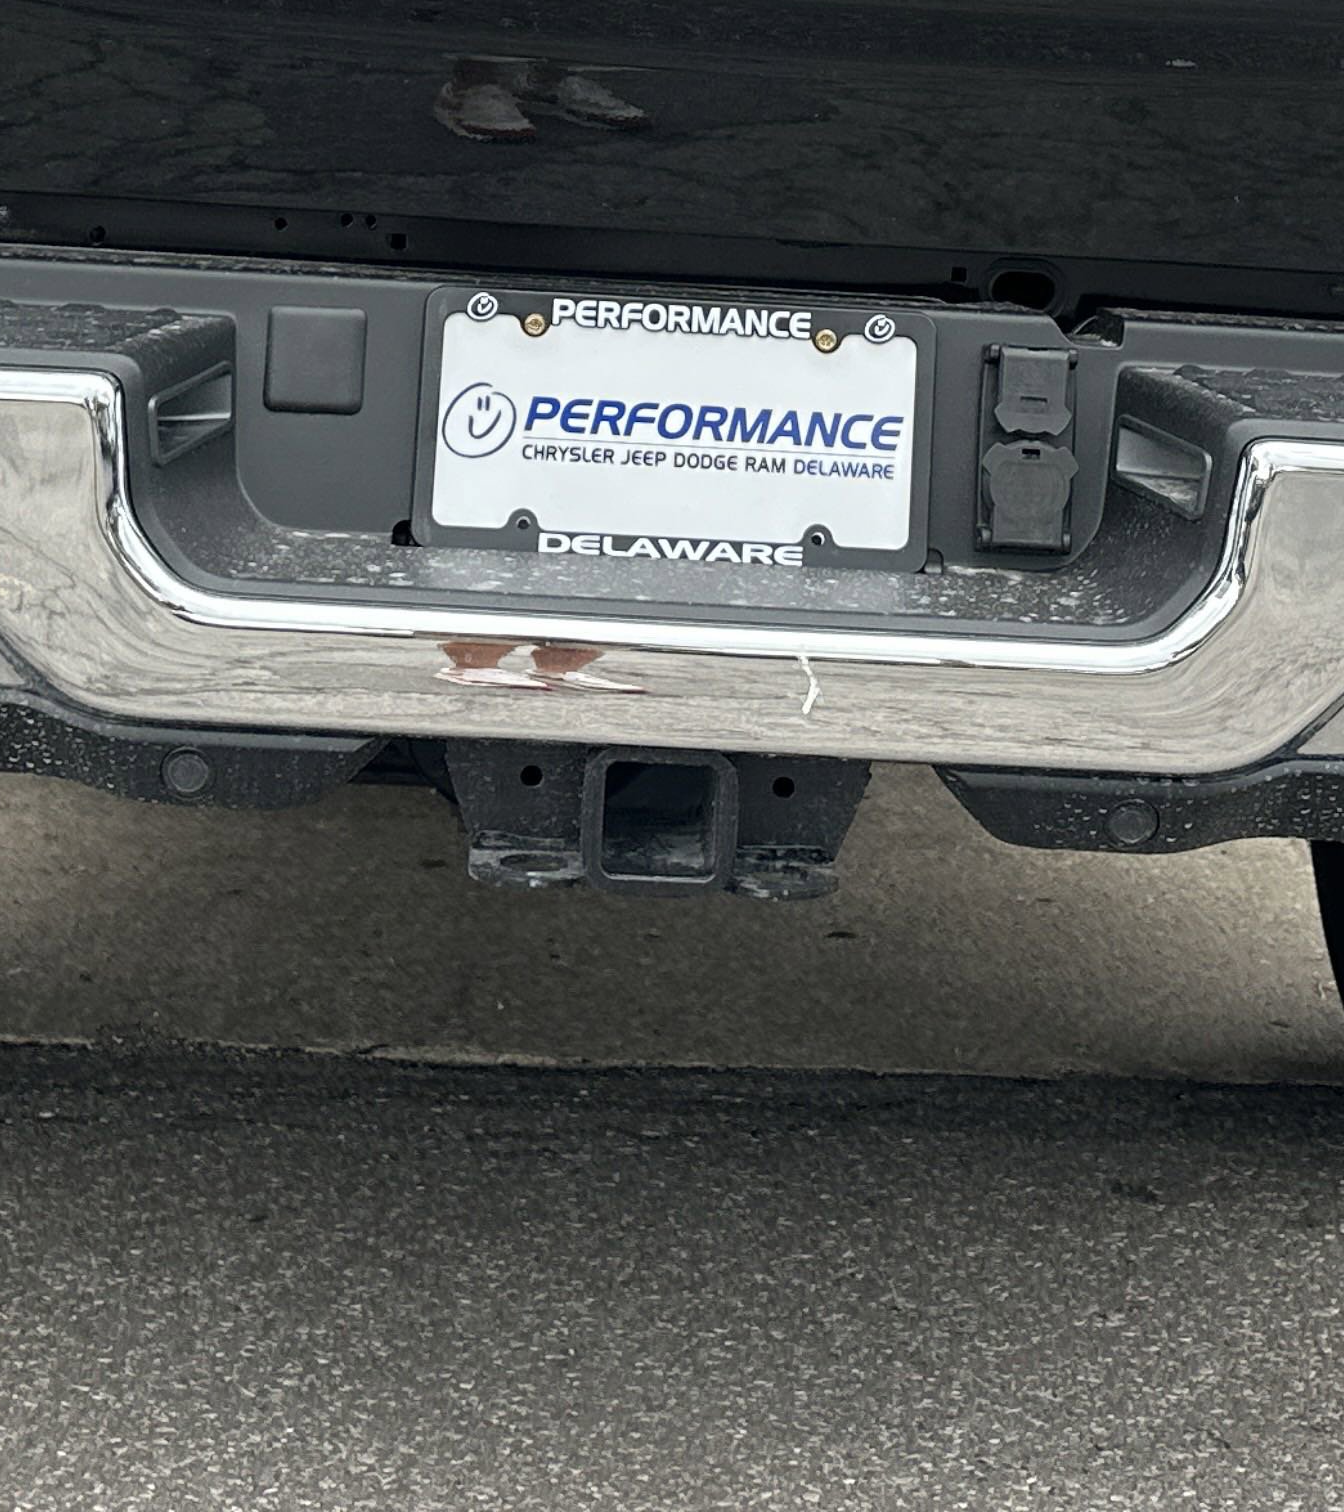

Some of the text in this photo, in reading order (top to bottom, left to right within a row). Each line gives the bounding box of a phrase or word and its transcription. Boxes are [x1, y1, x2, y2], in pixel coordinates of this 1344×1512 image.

[552, 297, 812, 340] PERFORMANCE
[524, 396, 904, 451] PERFORMANCE
[522, 444, 895, 480] CHRYSLER JEEP DODGE RAM DELAWARE
[538, 532, 804, 567] DELAWARE
